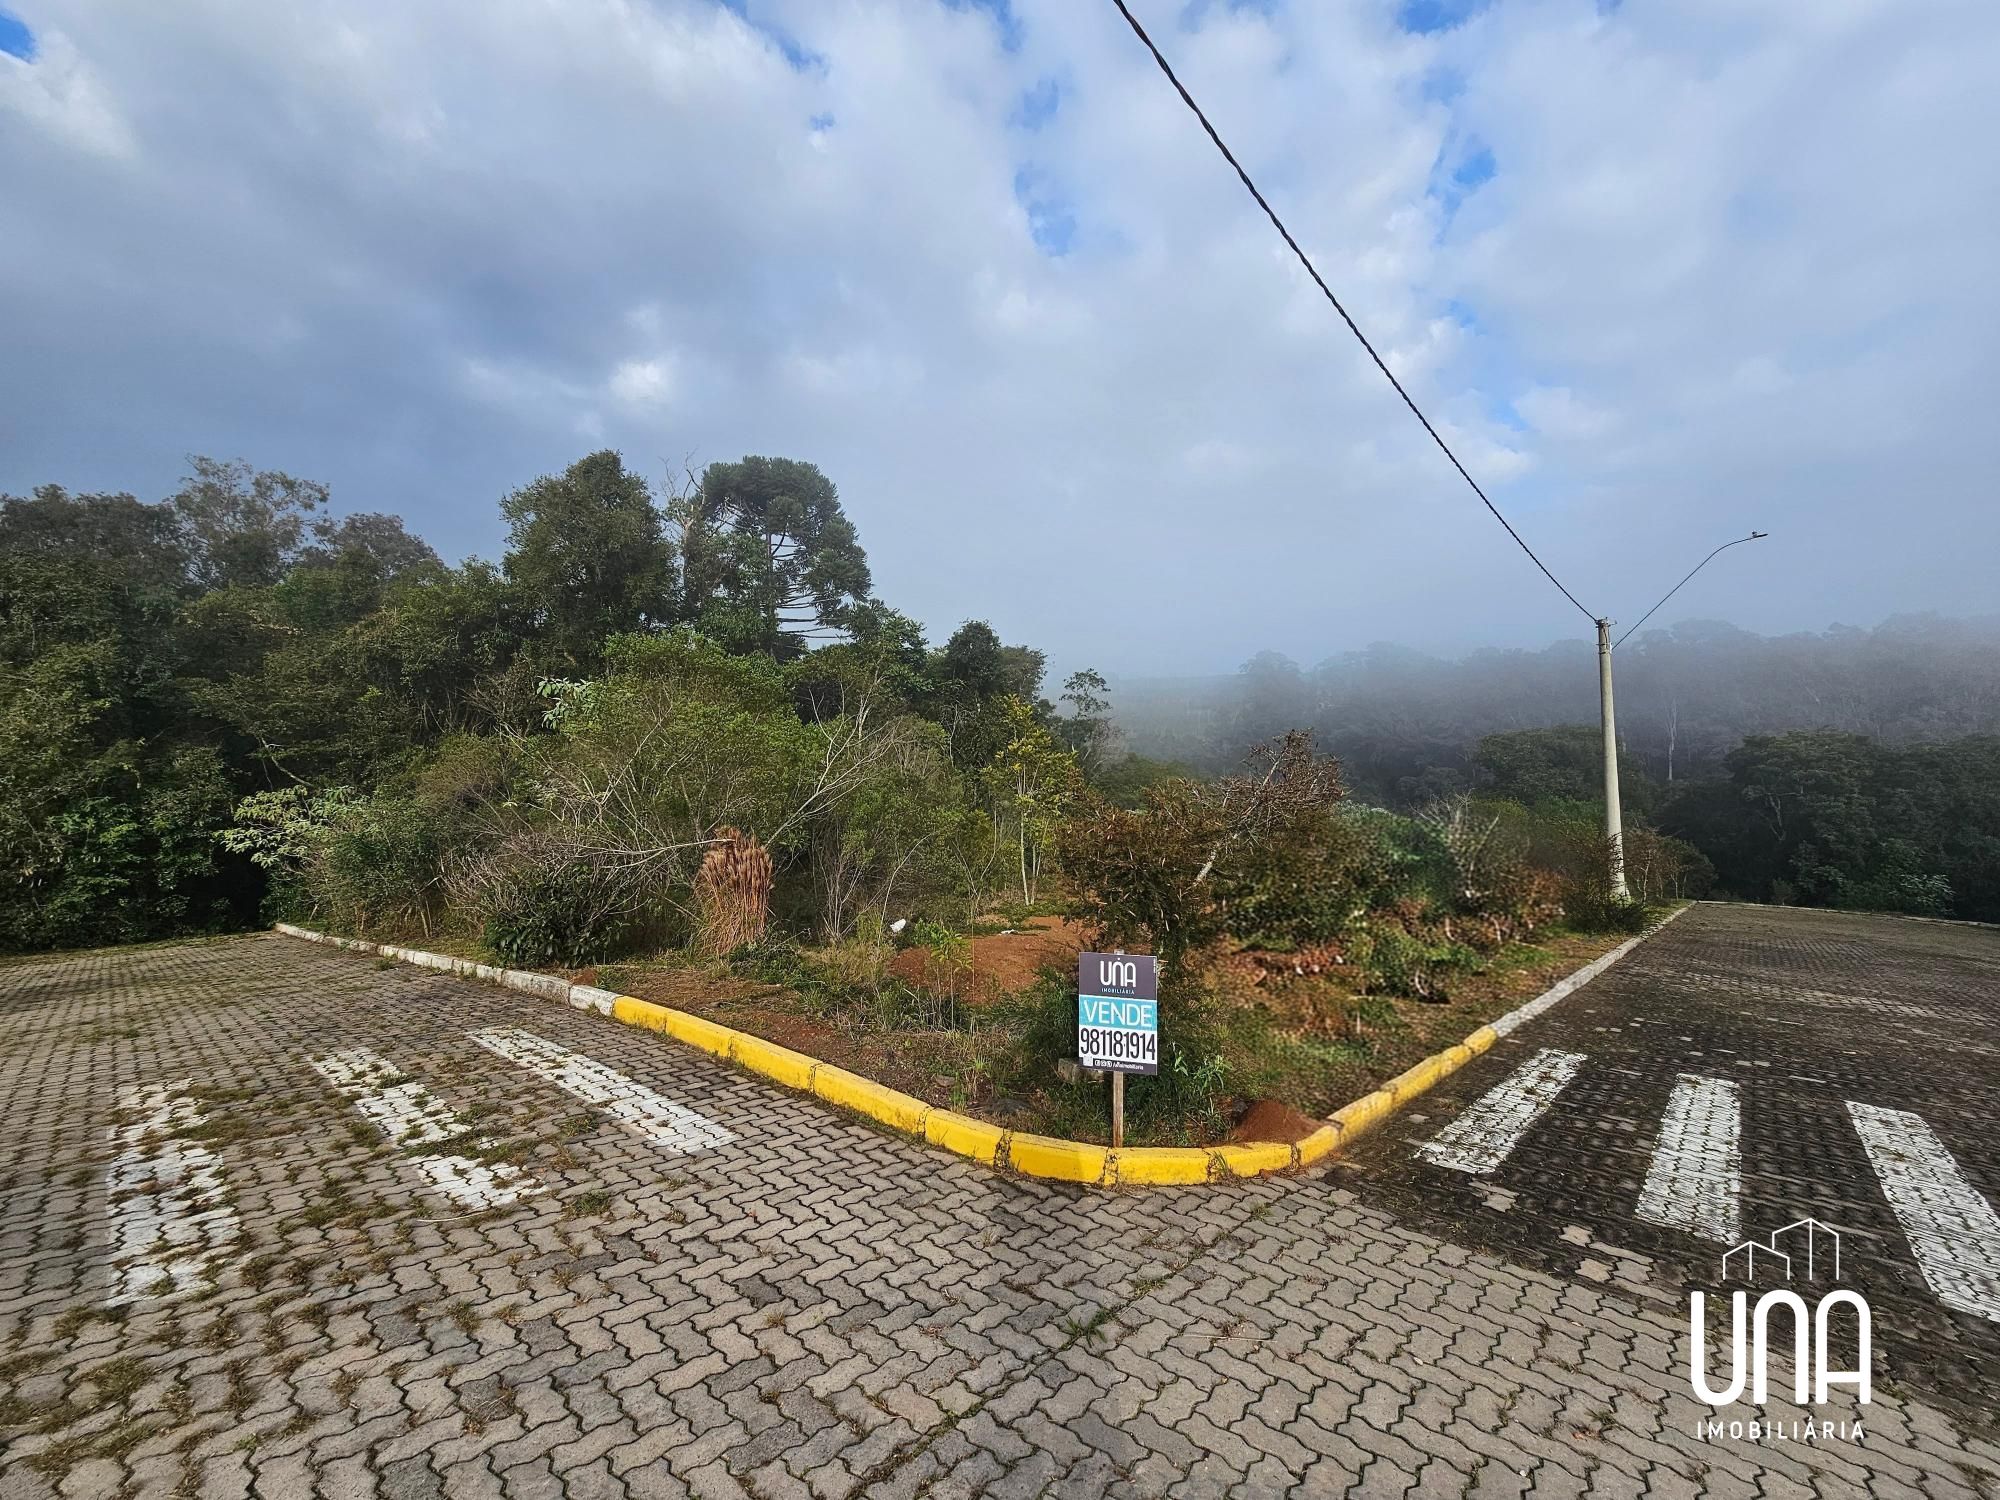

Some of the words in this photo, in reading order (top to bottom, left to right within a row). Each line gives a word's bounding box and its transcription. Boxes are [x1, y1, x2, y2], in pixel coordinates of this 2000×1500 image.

[1100, 960, 1137, 988] UNA
[1101, 987, 1135, 995] IMOBILIÁRIA
[1083, 1000, 1152, 1028] VENDE
[1080, 1027, 1156, 1061] 981181914
